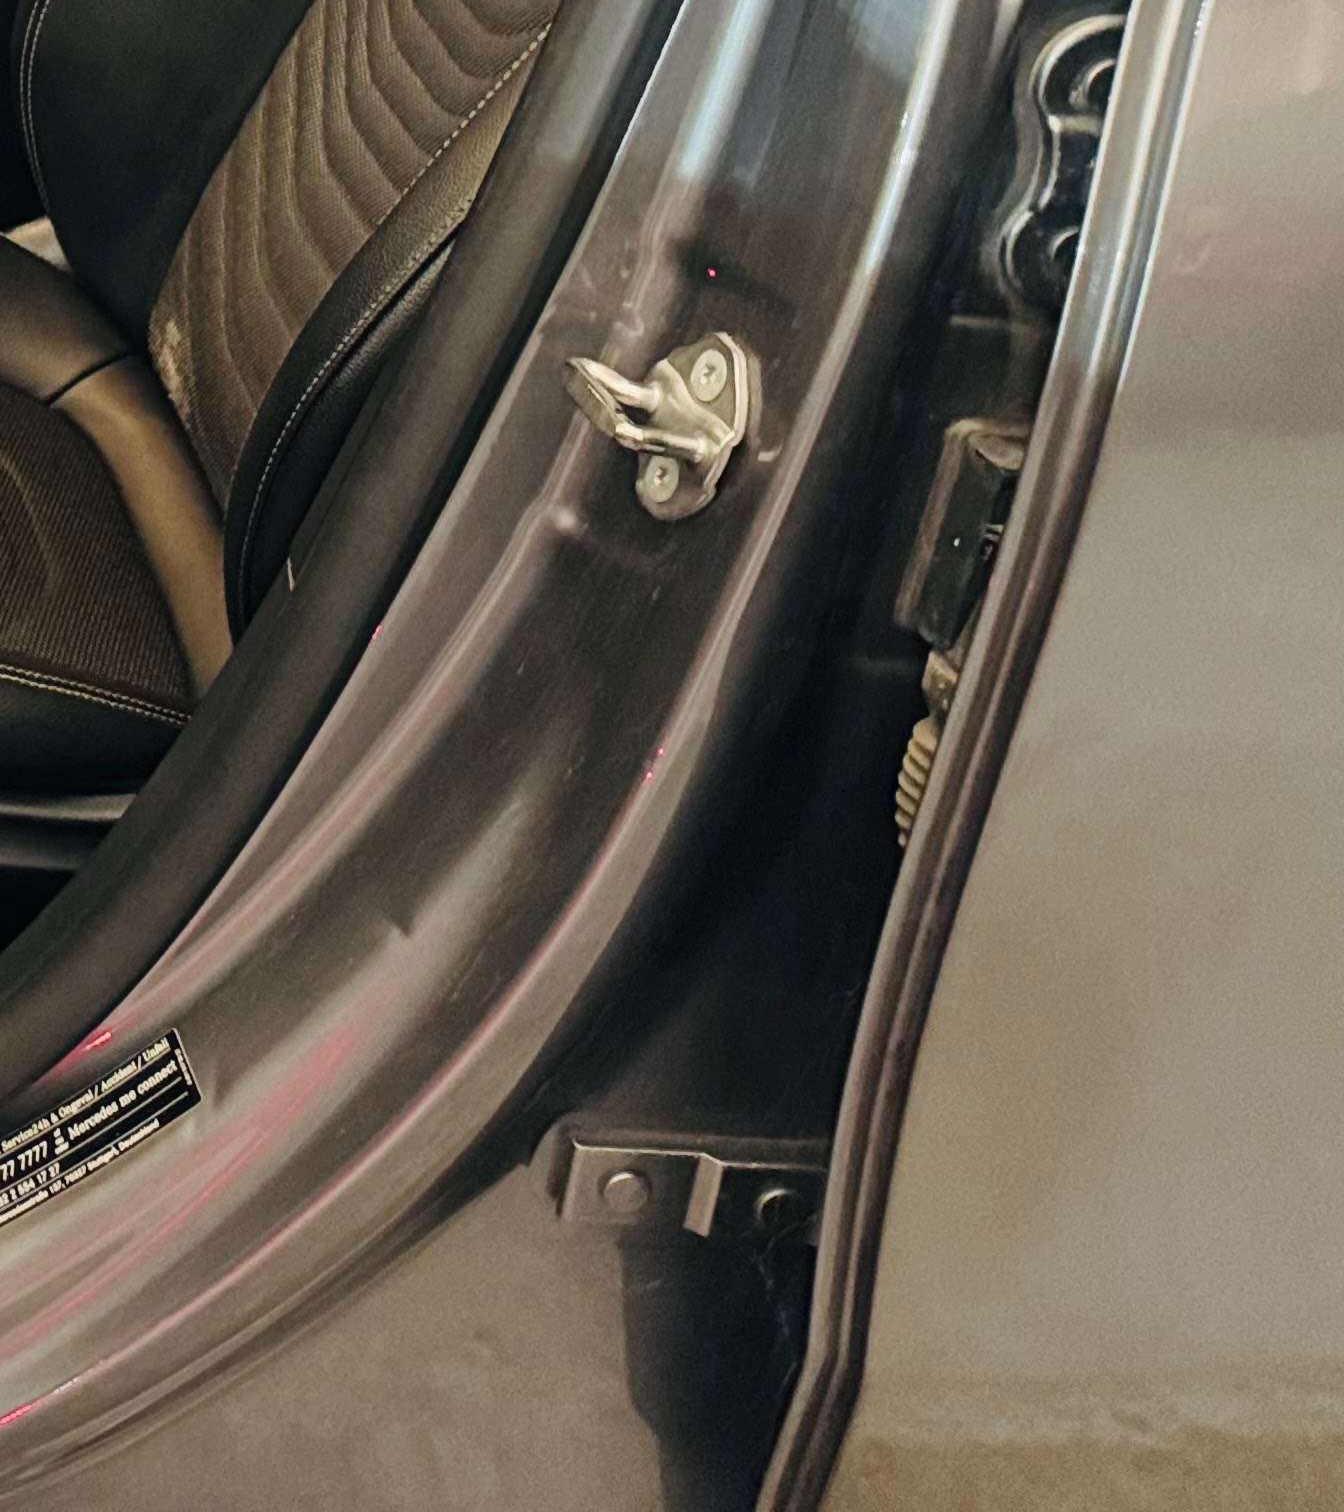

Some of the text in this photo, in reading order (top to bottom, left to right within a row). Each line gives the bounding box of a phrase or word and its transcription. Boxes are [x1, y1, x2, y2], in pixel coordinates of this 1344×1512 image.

[67, 1100, 118, 1140] Mercedes
[118, 1090, 137, 1108] me
[137, 1060, 178, 1095] connect
[17, 1140, 48, 1171] 7777
